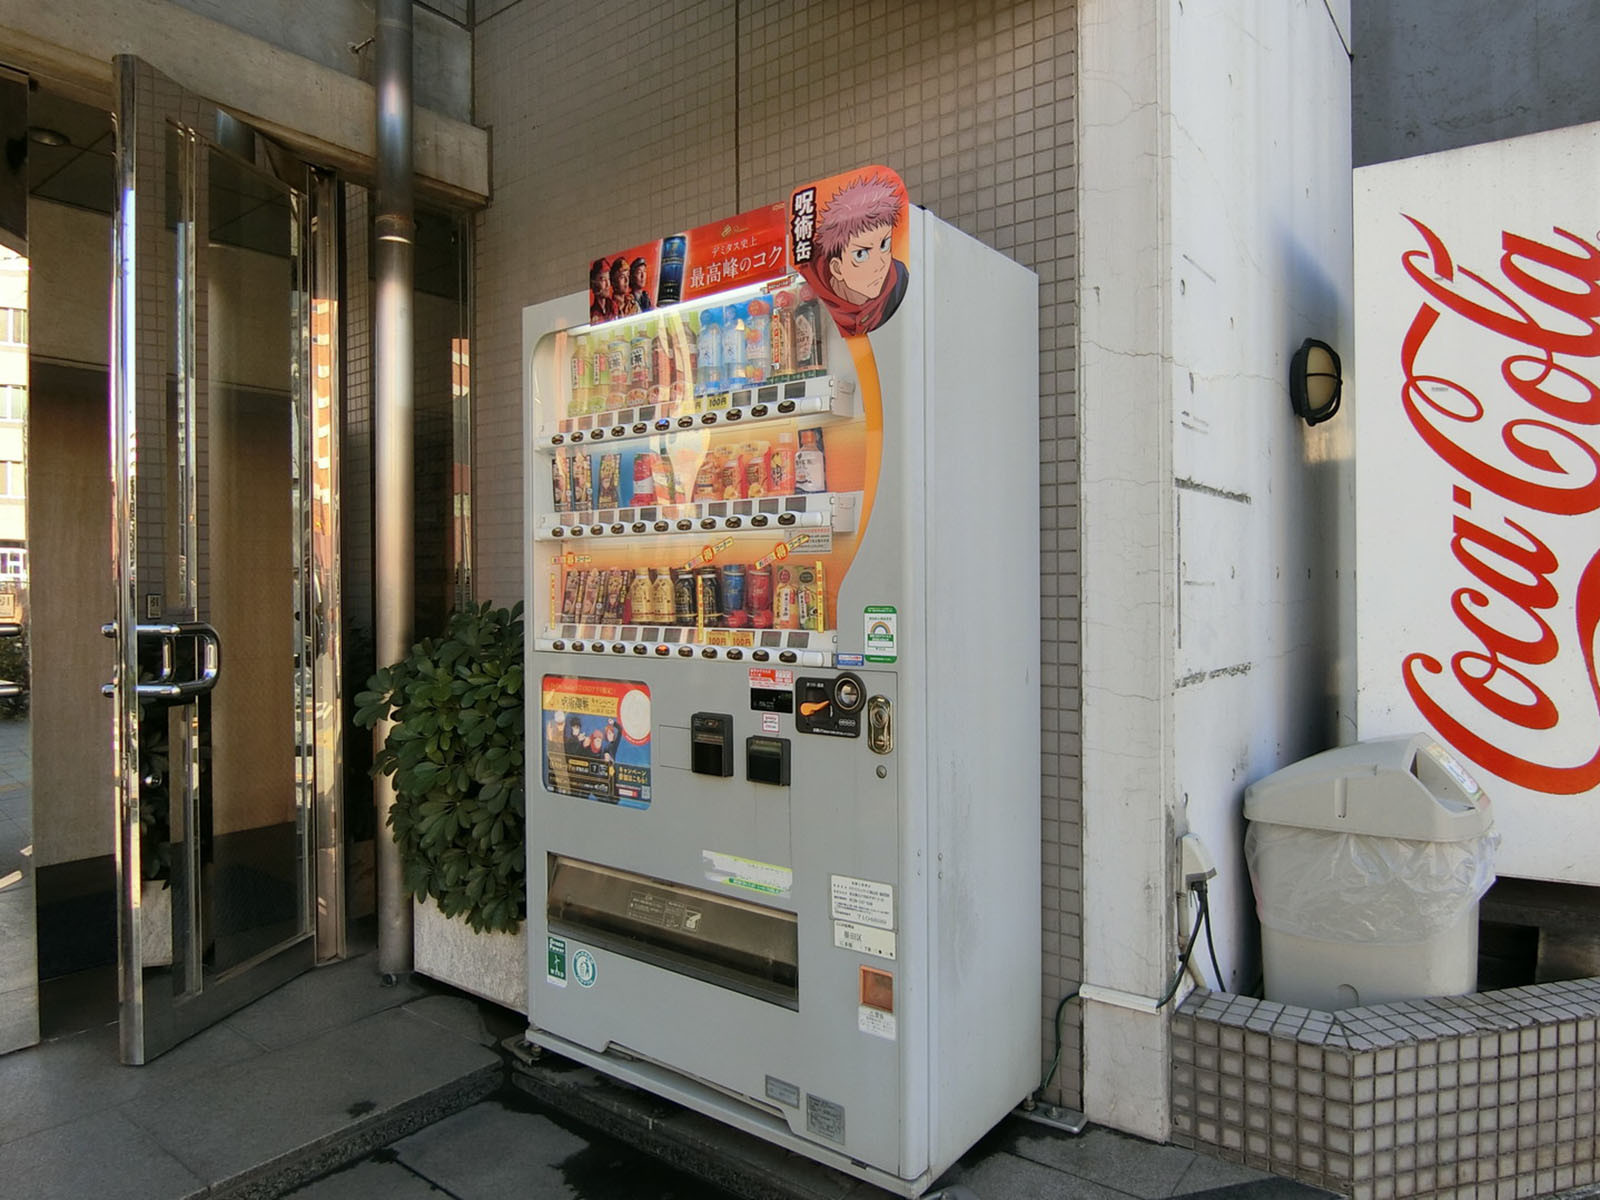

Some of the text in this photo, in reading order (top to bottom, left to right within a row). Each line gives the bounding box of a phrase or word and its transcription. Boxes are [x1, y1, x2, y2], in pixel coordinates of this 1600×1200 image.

[794, 189, 815, 262] 呪術缶
[711, 236, 758, 258] デミタス史上
[689, 245, 783, 289] 最高峰のコク
[709, 396, 728, 409] 100円
[1399, 212, 1600, 796] Coca-Cola
[619, 766, 647, 776] キャンペーン
